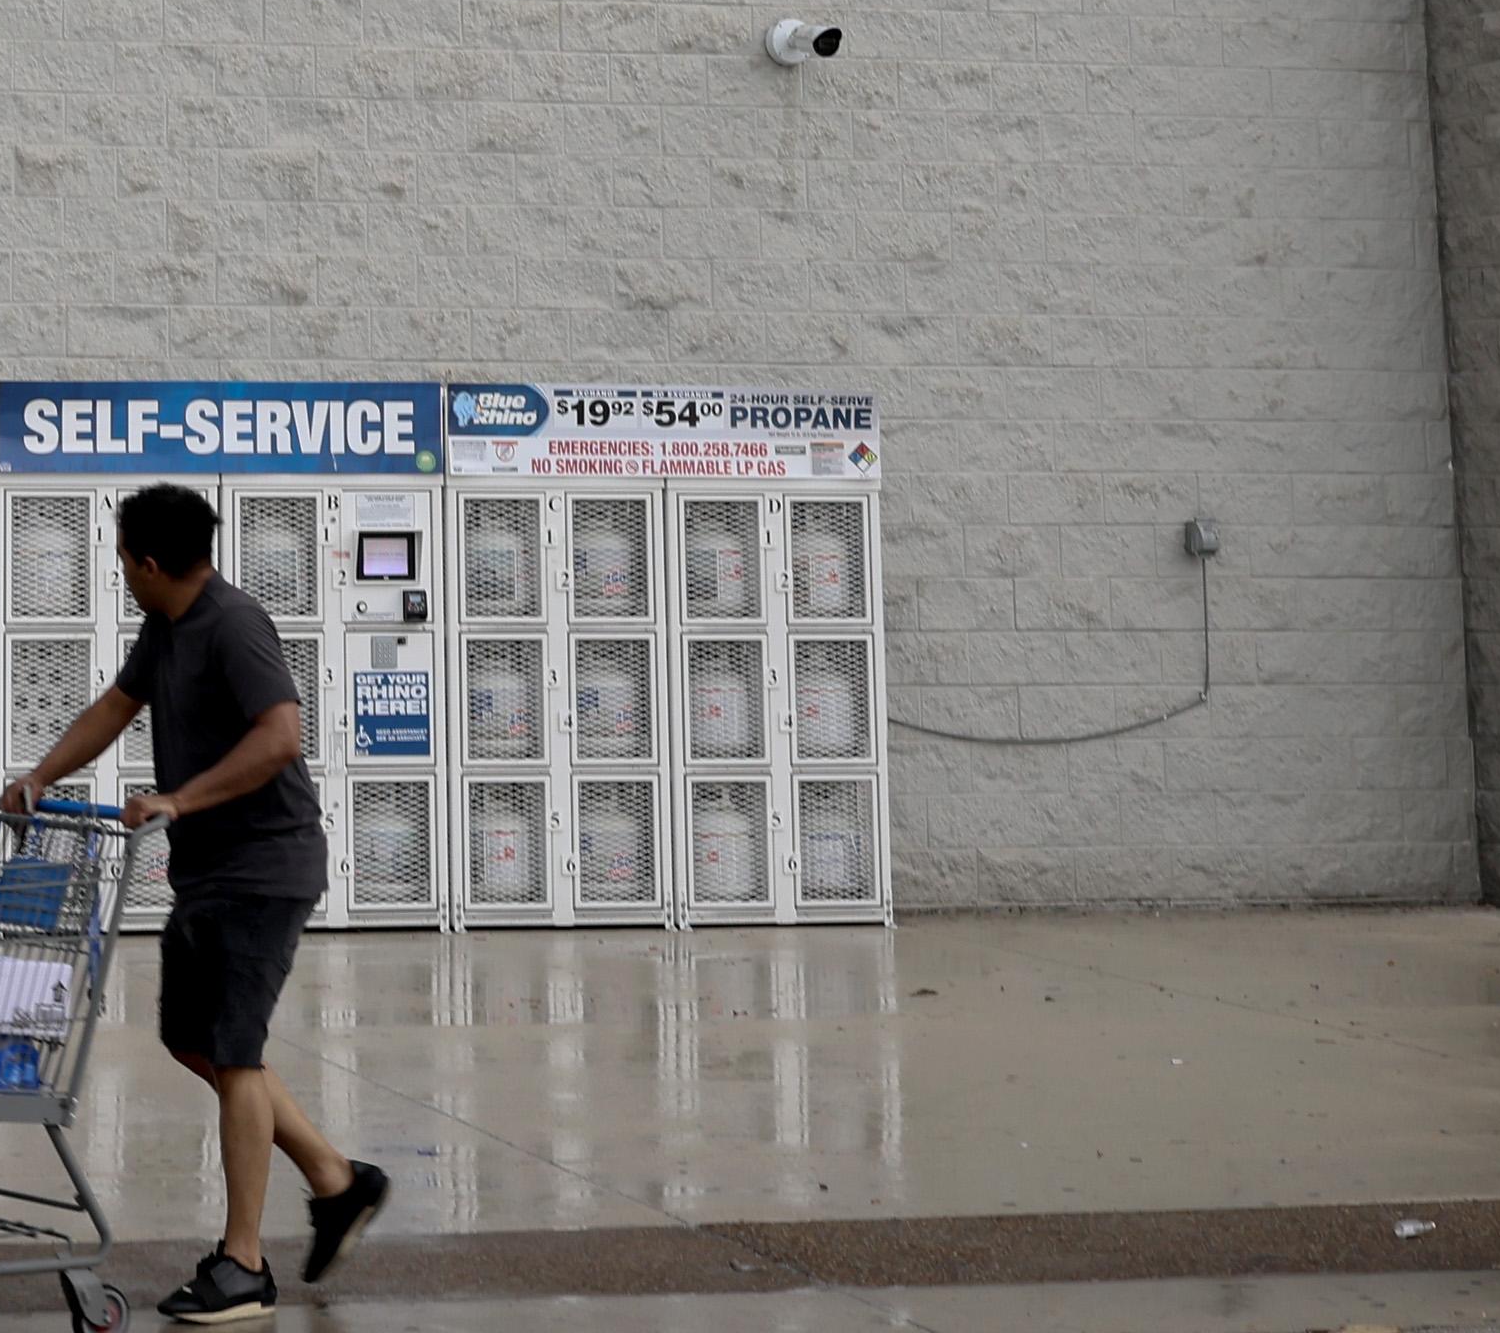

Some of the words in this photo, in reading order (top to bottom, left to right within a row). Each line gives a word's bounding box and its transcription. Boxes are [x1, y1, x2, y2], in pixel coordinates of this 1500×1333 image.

[478, 392, 527, 410] Blue
[730, 394, 790, 406] 24-HOUR
[793, 395, 873, 407] SELF-SERVE
[474, 409, 538, 426] Rhino
[730, 406, 873, 431] PROPANE
[23, 399, 416, 455] SELF-SERVICE
[548, 440, 654, 457] EMERGENCIES:
[660, 441, 768, 458] 1.800.258.7466
[531, 458, 552, 475] NO
[554, 458, 624, 476] SMOKING
[642, 459, 732, 477] FLAMMABLE
[736, 461, 753, 476] LP
[756, 461, 786, 477] GAS
[101, 494, 113, 510] A
[328, 494, 339, 510] B
[549, 496, 562, 512] C
[769, 498, 781, 514] D
[97, 526, 102, 541] 1
[765, 529, 771, 545] 1
[110, 571, 119, 587] 2
[338, 569, 347, 586] 2
[561, 571, 570, 587] 2
[780, 572, 789, 588] 2
[95, 669, 105, 685] 3
[324, 667, 333, 685] 3
[356, 674, 384, 684] GET
[387, 674, 426, 684] YOUR
[548, 669, 557, 685] 3
[356, 684, 427, 699] RHINO
[357, 699, 427, 716] HERE!
